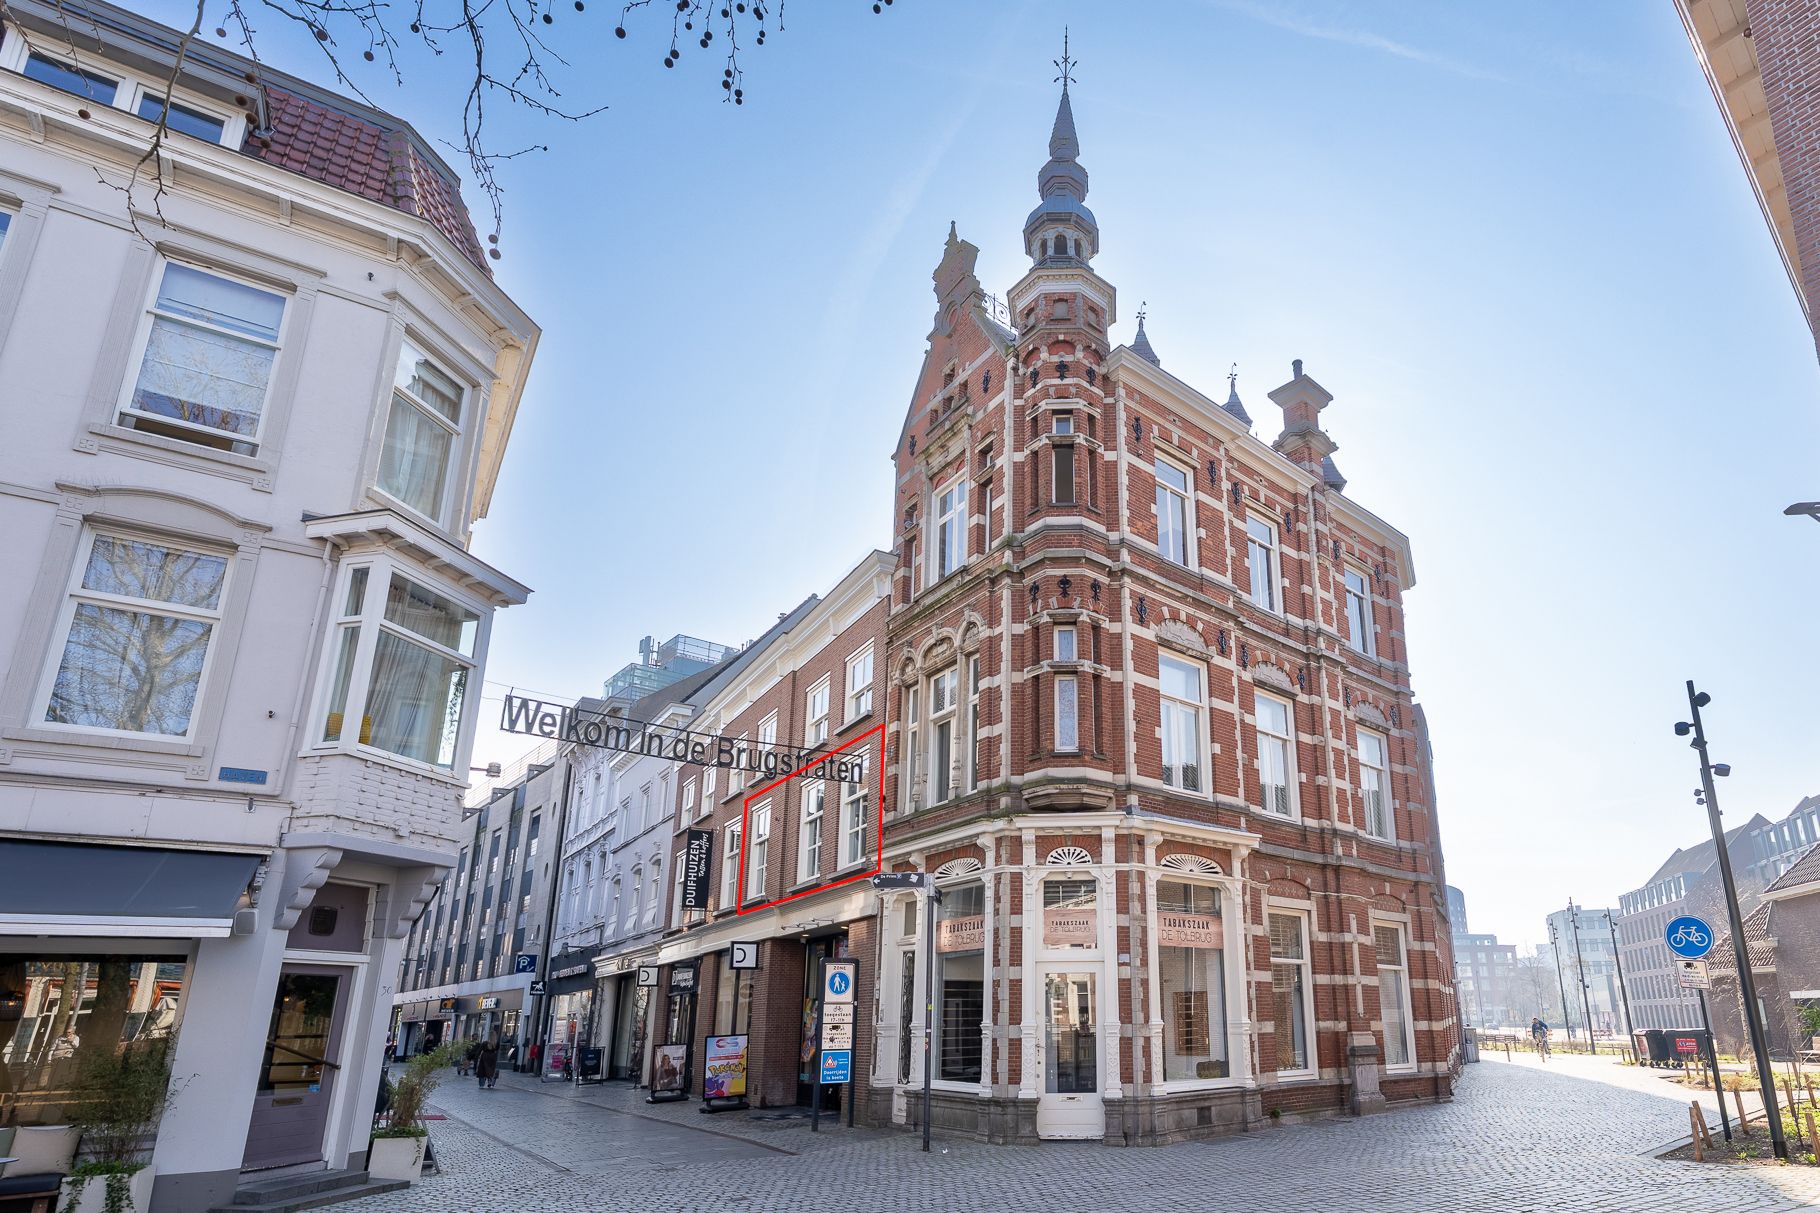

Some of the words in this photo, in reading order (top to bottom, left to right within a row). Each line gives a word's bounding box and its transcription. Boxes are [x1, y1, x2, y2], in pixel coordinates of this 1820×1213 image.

[506, 695, 631, 751] Welkom
[639, 723, 664, 757] in
[673, 730, 705, 764] de
[717, 736, 864, 782] Brugstraten
[685, 840, 700, 906] DUIFHUIZEN
[945, 920, 985, 934] TABAKSZAAK
[1162, 916, 1210, 930] TABAKSZAAK
[943, 935, 953, 947] DE
[955, 931, 985, 946] TOLBRUG
[1161, 929, 1173, 941] DE
[1176, 930, 1212, 944] TOLBRUG
